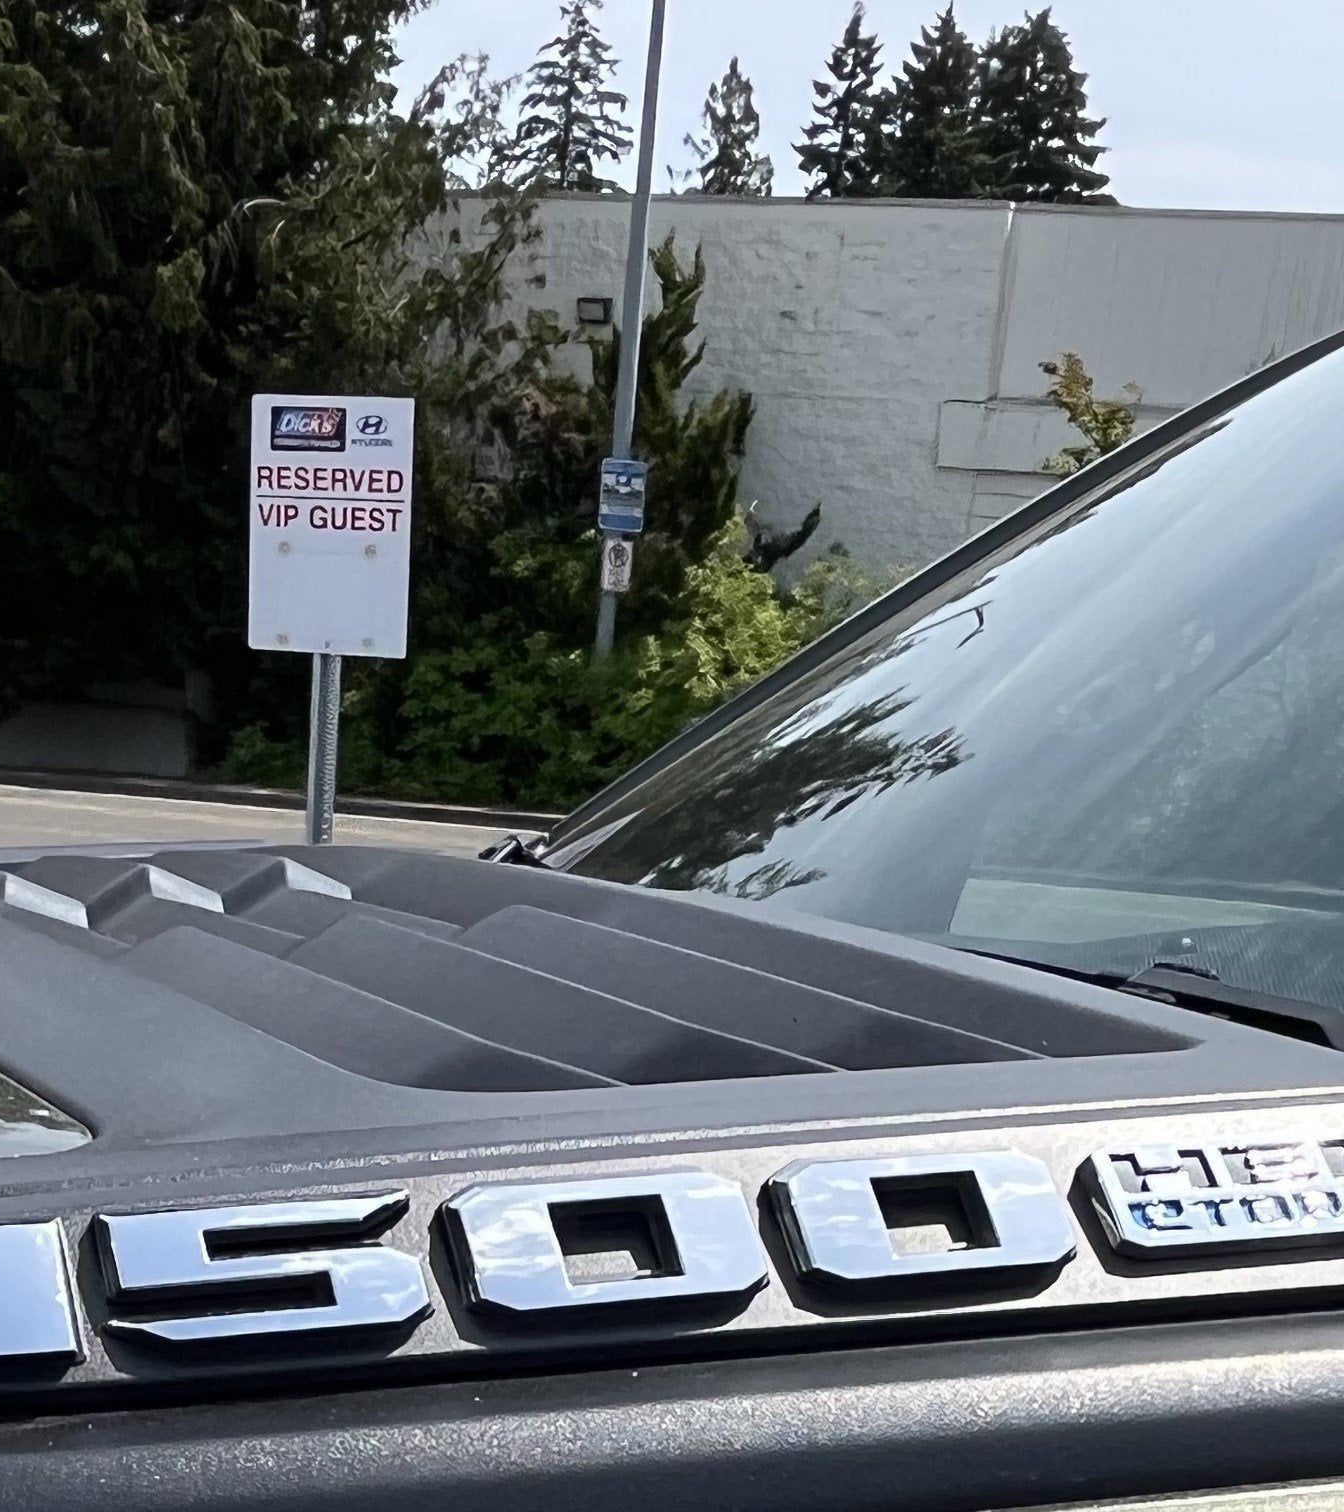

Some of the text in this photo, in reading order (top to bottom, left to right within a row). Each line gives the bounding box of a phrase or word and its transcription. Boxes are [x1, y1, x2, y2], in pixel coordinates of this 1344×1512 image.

[257, 466, 404, 494] RESERVED
[258, 503, 403, 532] VIP GUEST
